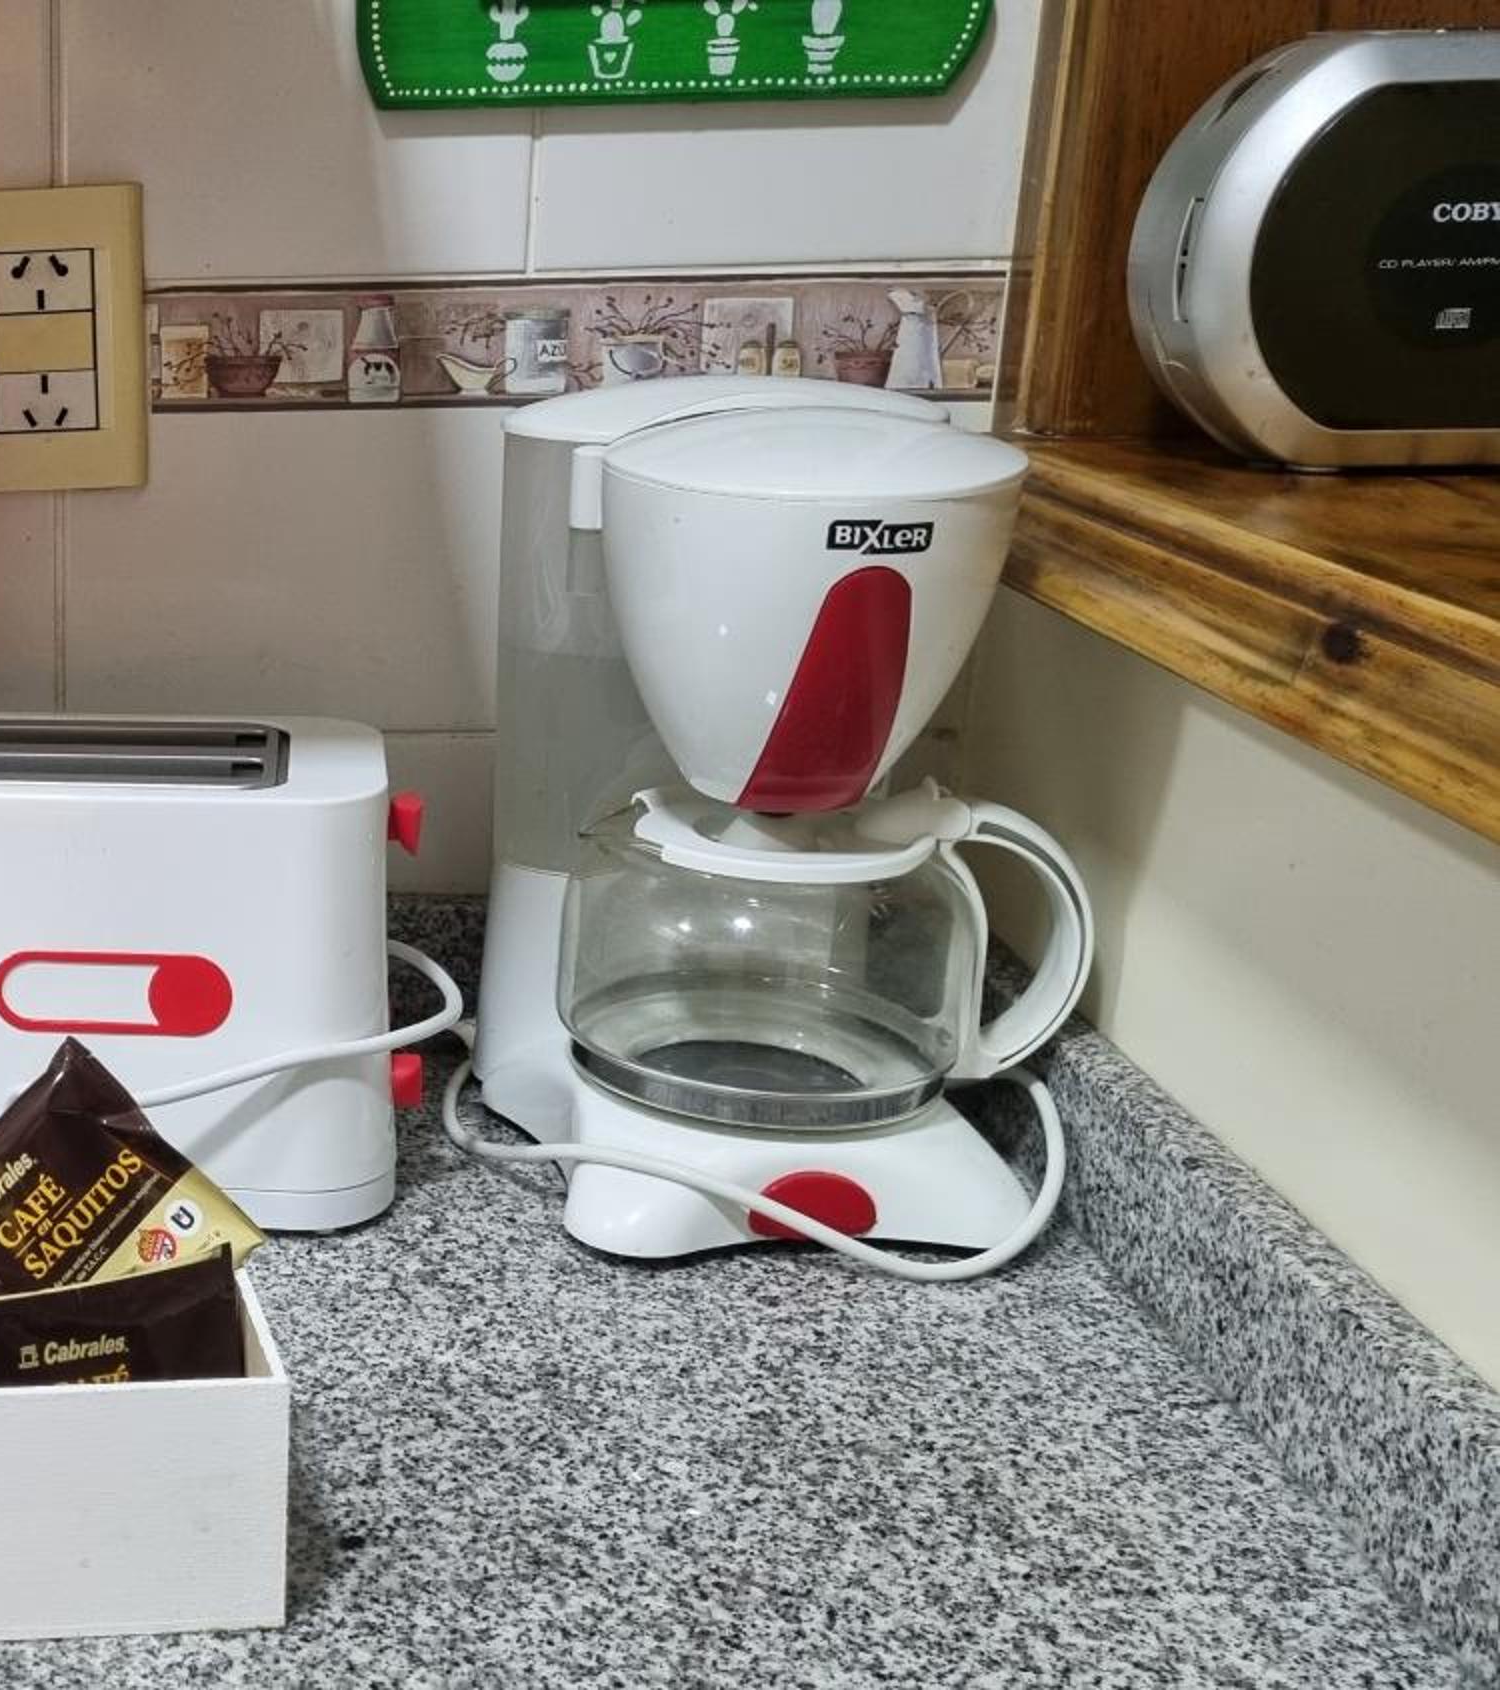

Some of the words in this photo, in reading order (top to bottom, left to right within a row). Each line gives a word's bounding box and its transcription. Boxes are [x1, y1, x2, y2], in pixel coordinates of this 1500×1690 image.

[1379, 259, 1399, 269] CD
[23, 1148, 142, 1280] SAQUITOS
[37, 1217, 54, 1236] en
